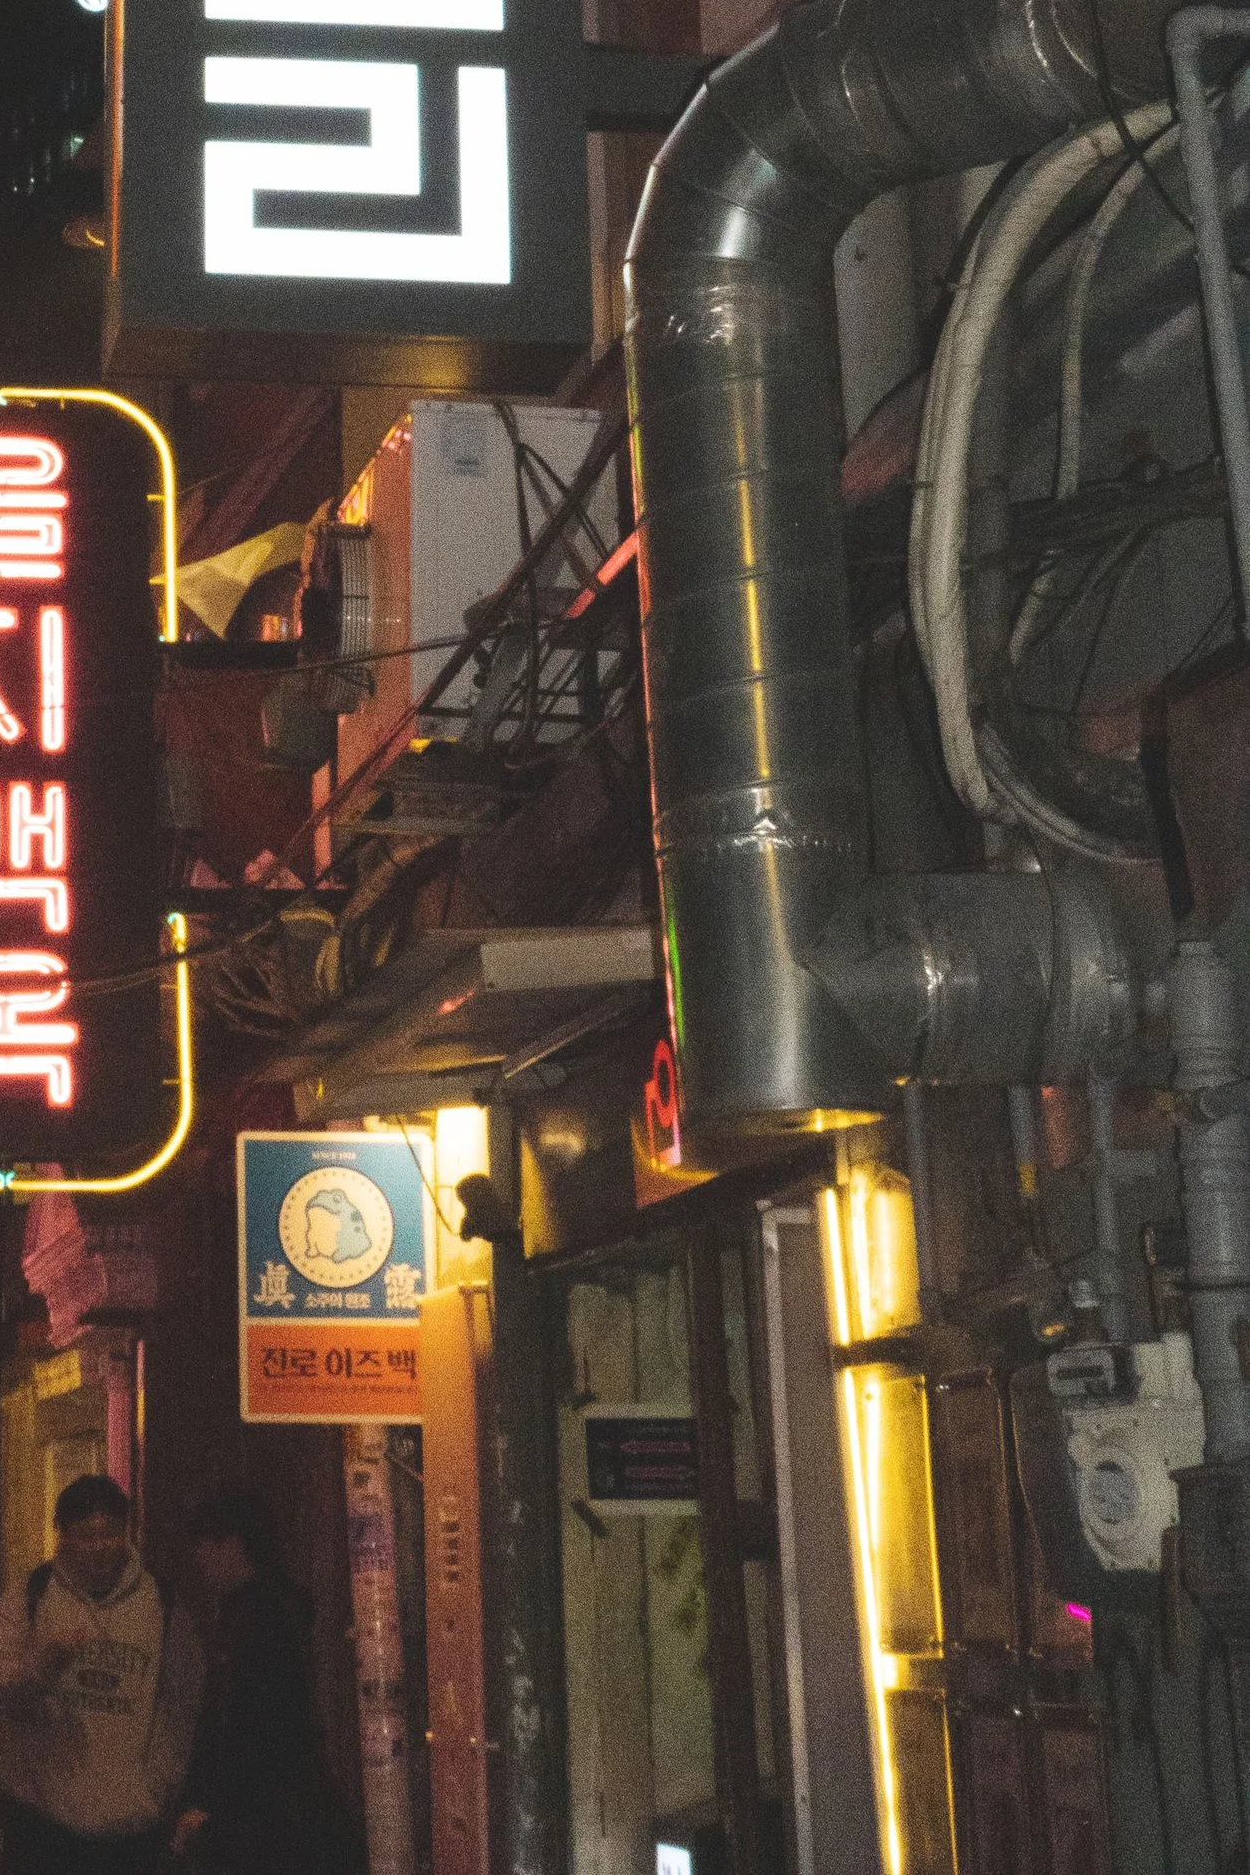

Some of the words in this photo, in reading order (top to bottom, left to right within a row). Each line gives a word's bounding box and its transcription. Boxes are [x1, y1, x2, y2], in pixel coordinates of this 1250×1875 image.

[260, 1346, 318, 1379] 진로
[325, 1346, 384, 1379] 이즈
[386, 1348, 418, 1380] 백
